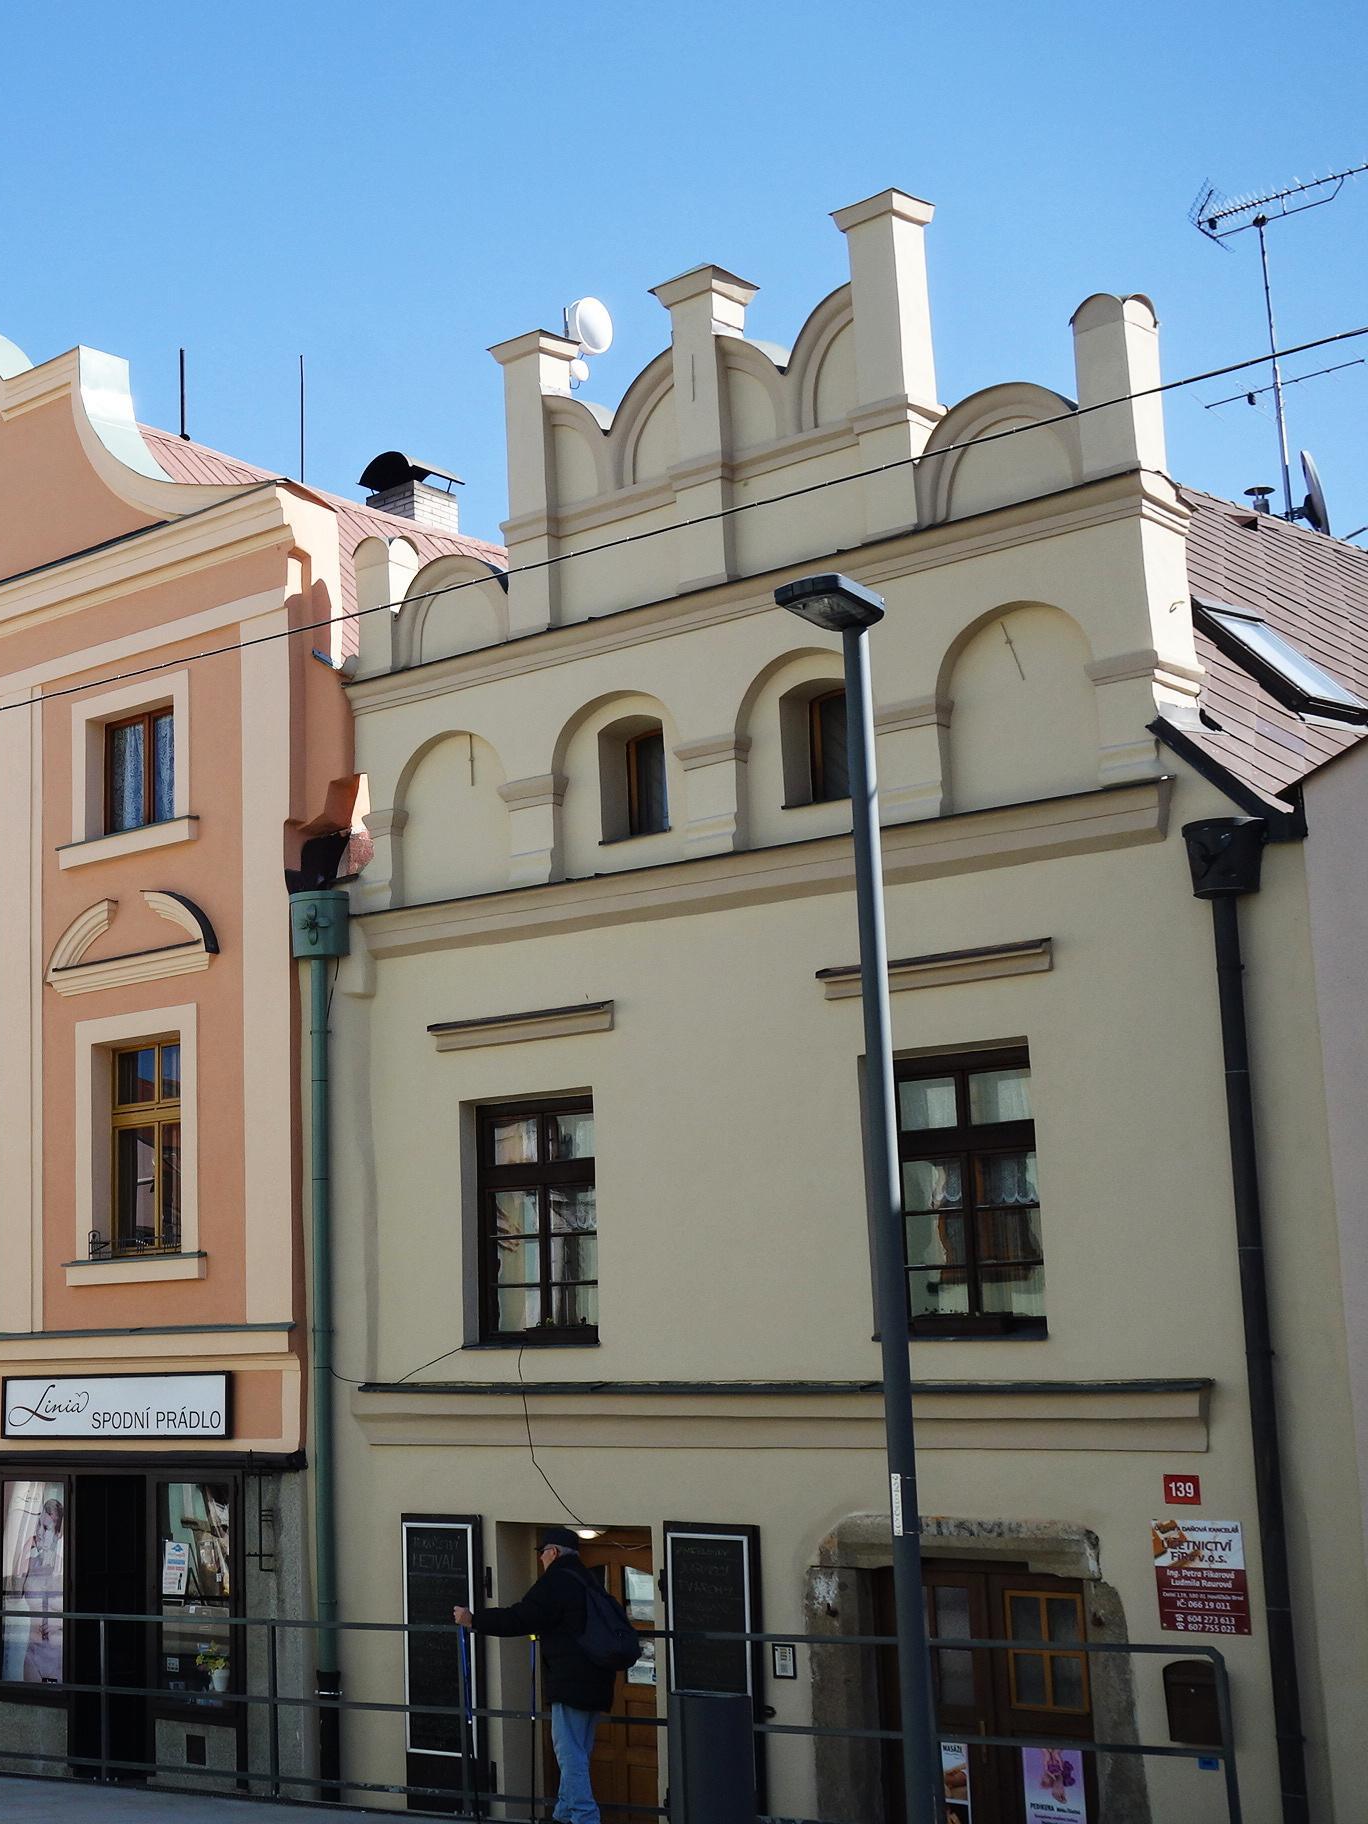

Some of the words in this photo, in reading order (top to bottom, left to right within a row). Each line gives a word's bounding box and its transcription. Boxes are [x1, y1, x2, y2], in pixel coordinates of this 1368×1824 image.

[8, 1384, 90, 1427] Linia
[91, 1407, 151, 1429] SPODNÍ
[156, 1406, 221, 1429] PRÁDLO
[1168, 1481, 1194, 1498] 139
[1182, 1525, 1207, 1533] DAŇOVÁ
[1208, 1526, 1239, 1534] KANCELÁŘ
[1198, 1554, 1227, 1563] v.o.s.
[1166, 1569, 1180, 1578] Ing.
[1181, 1569, 1202, 1578] Petra
[1171, 1579, 1200, 1587] Ludmila
[1205, 1601, 1215, 1609] 19
[1215, 1602, 1231, 1610] 011
[1203, 1616, 1219, 1624] 273
[1220, 1617, 1235, 1625] 613
[1204, 1624, 1220, 1632] 755
